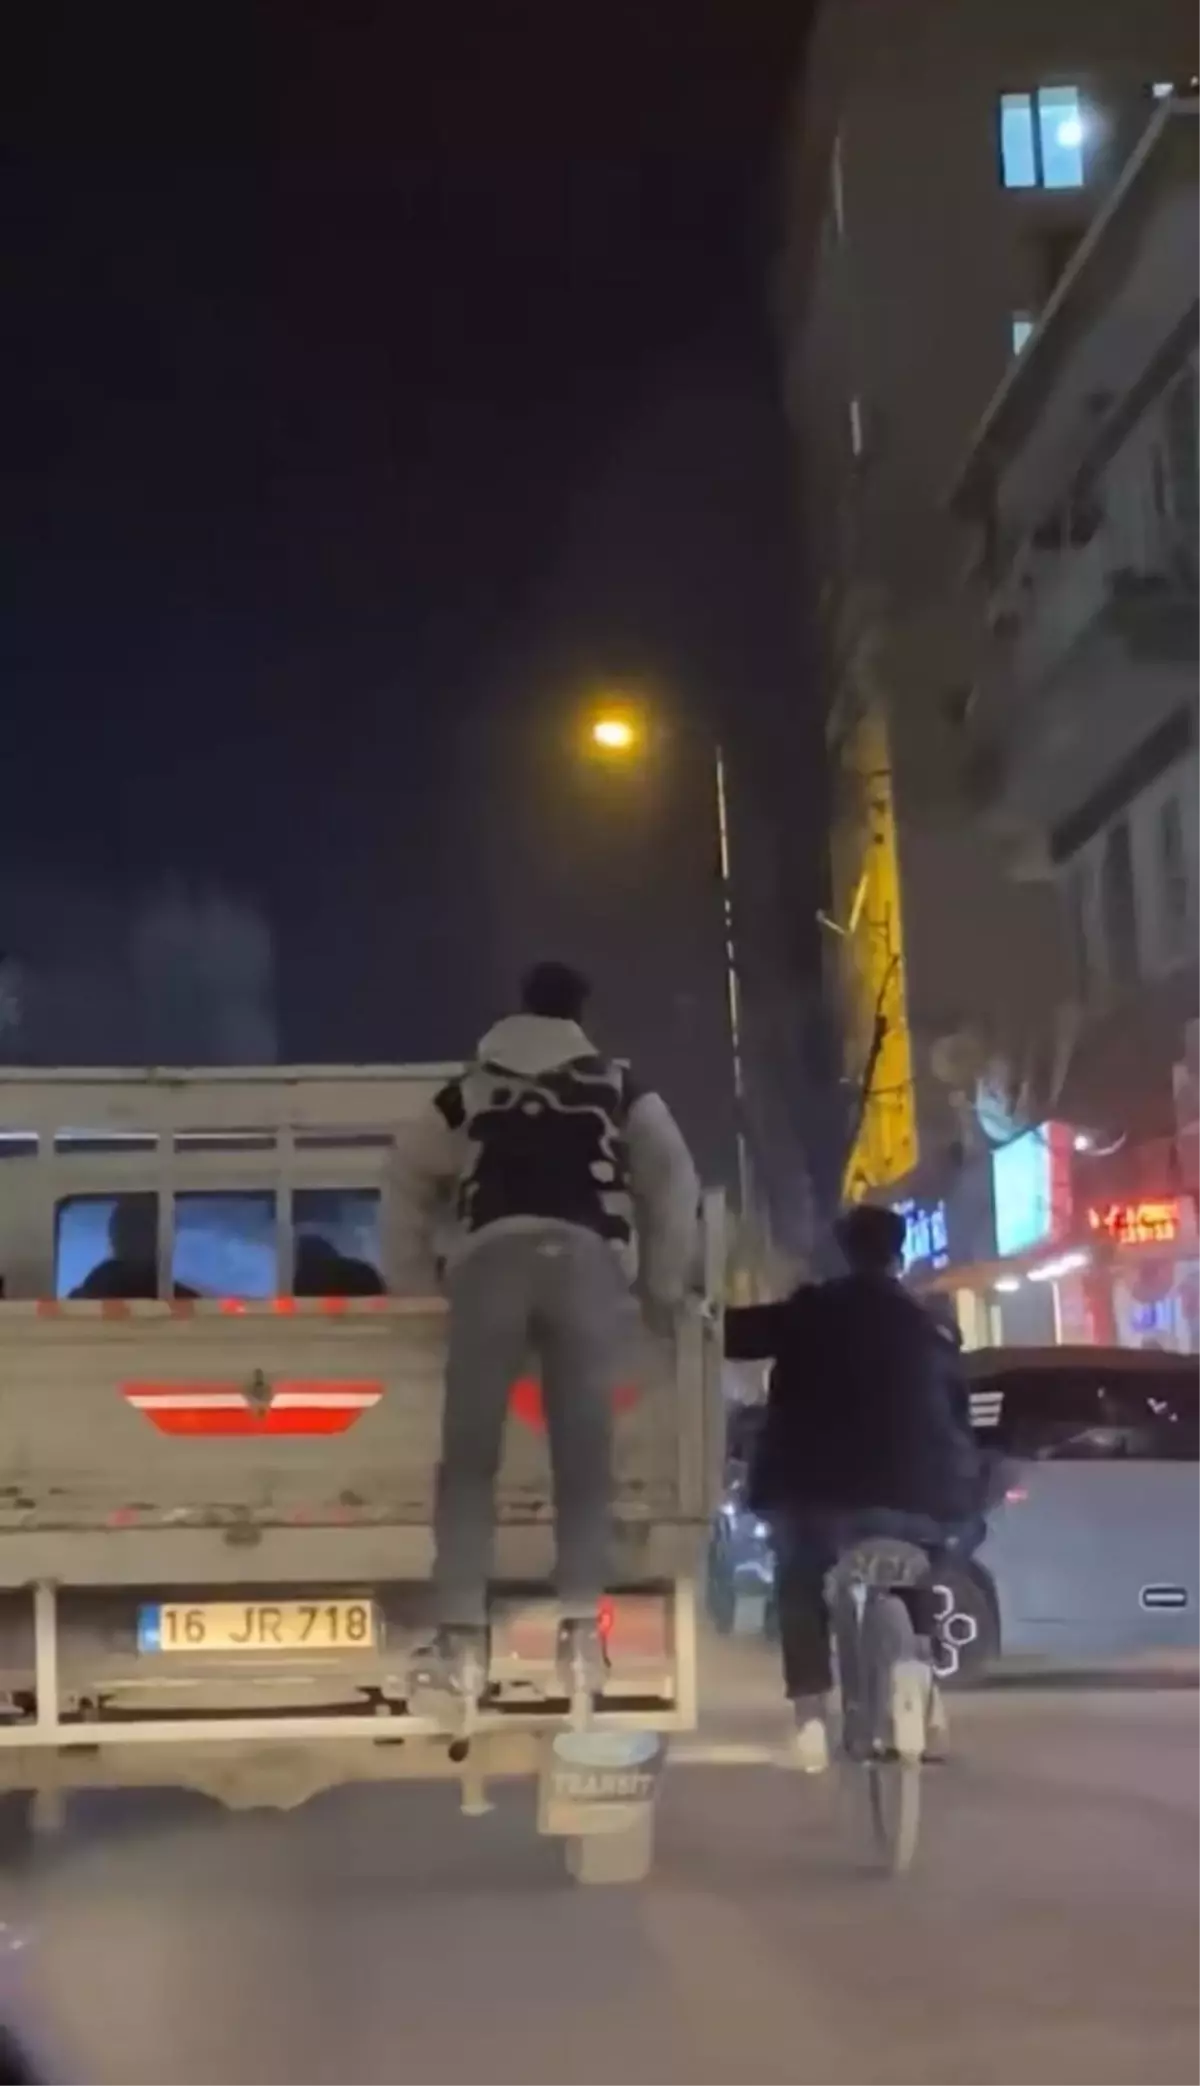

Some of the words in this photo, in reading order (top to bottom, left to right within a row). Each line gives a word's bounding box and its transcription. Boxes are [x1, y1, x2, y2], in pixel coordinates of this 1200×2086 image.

[164, 1608, 206, 1643] 16
[229, 1606, 283, 1643] JR
[298, 1604, 368, 1642] 718
